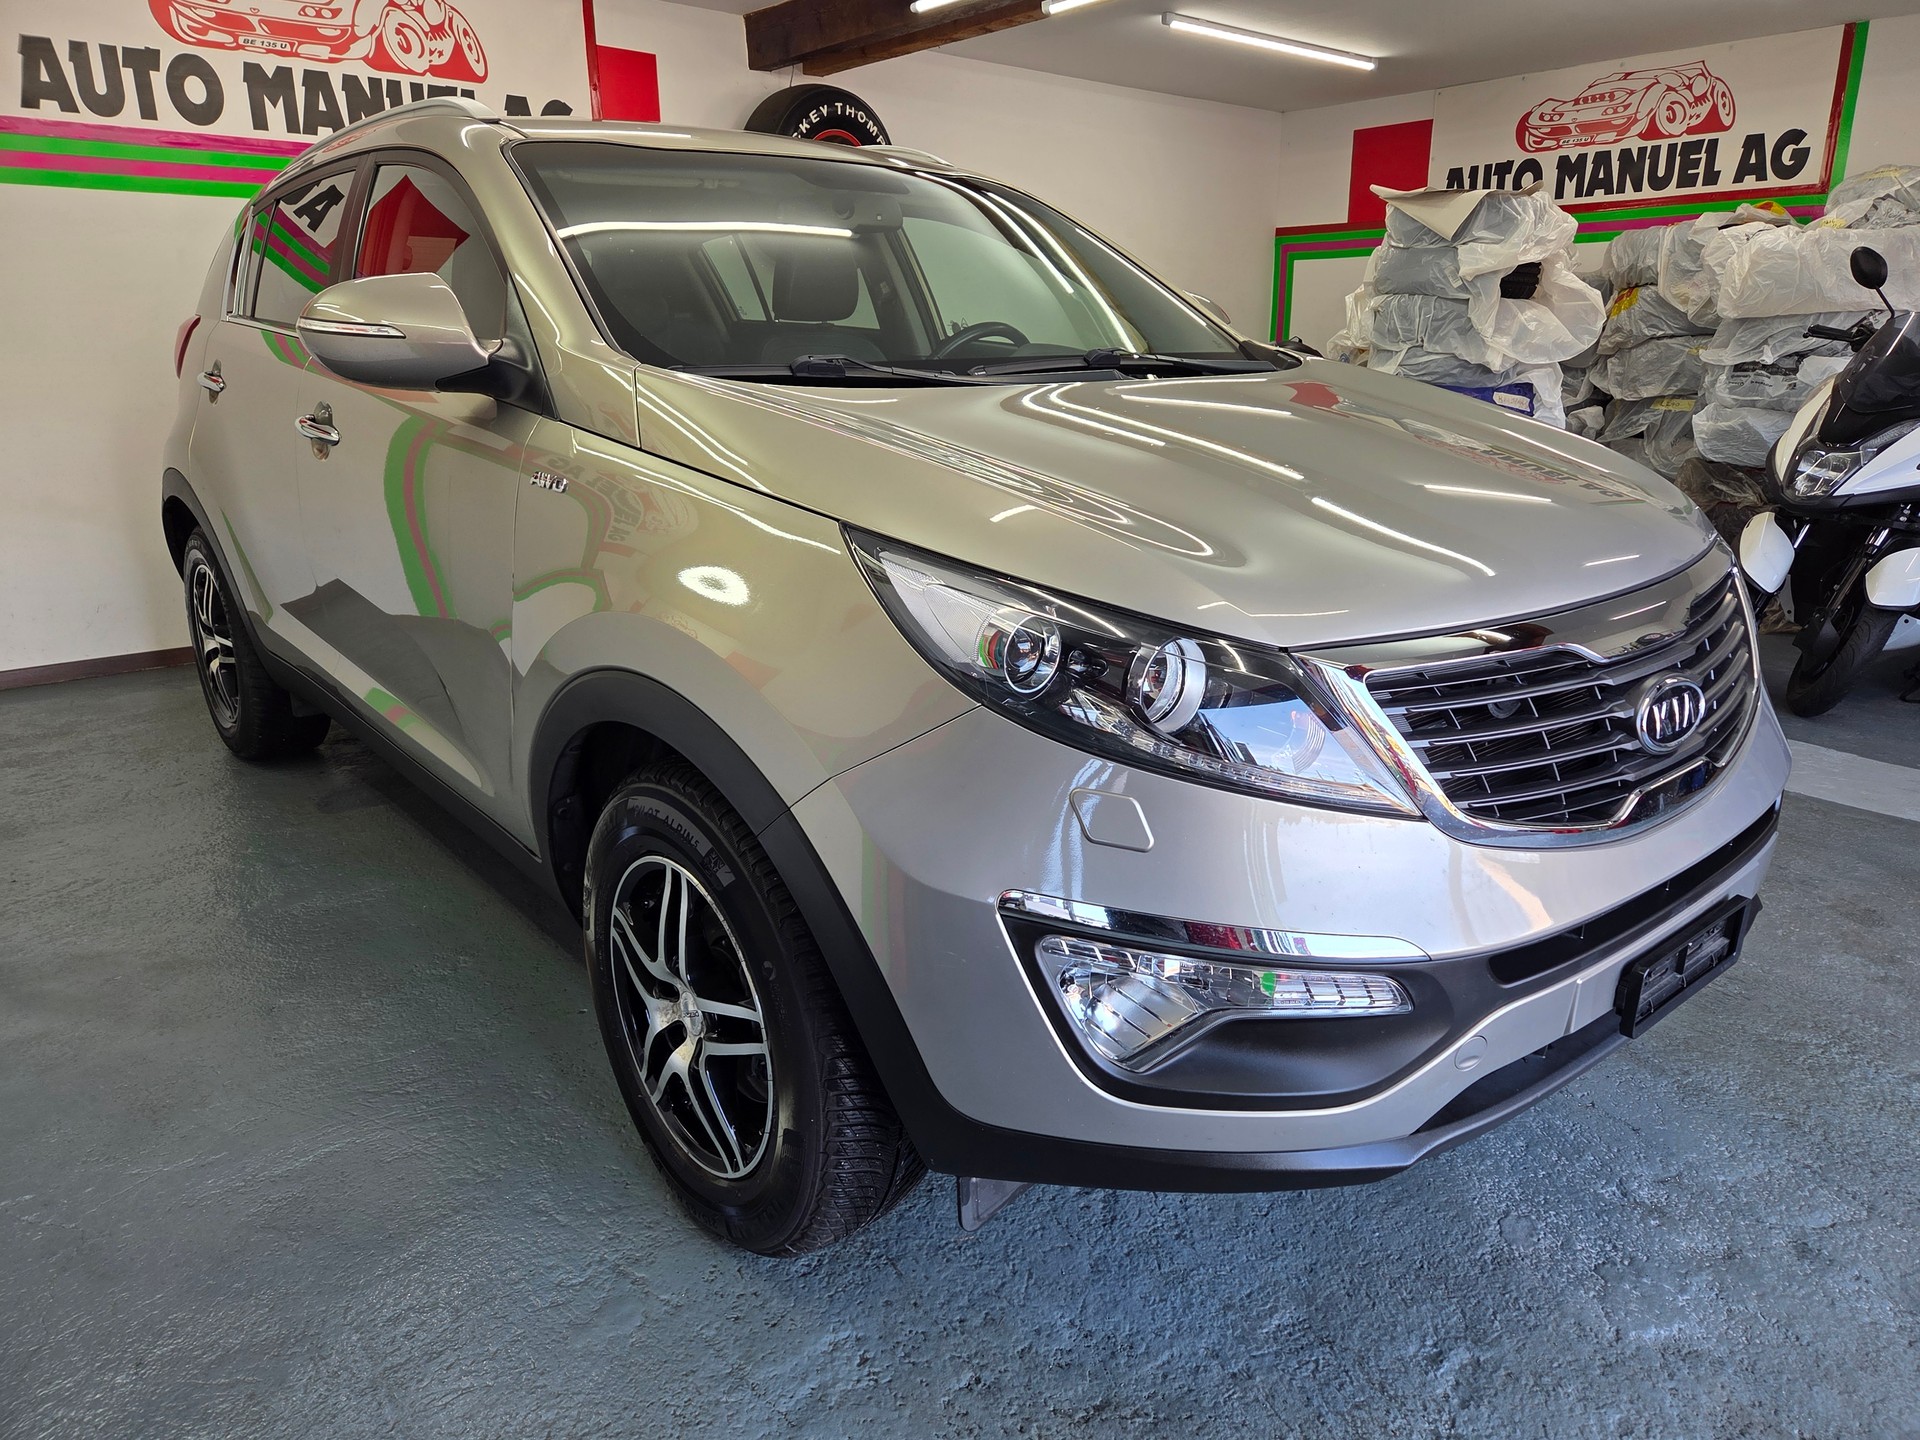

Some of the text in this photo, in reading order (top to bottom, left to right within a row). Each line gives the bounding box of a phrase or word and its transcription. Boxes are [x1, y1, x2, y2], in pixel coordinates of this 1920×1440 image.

[260, 40, 277, 48] 135
[18, 33, 225, 126] AUTO
[1554, 138, 1722, 200] MANUEL
[1732, 128, 1811, 184] AG
[530, 471, 568, 493] AWD
[1652, 690, 1696, 740] KIA
